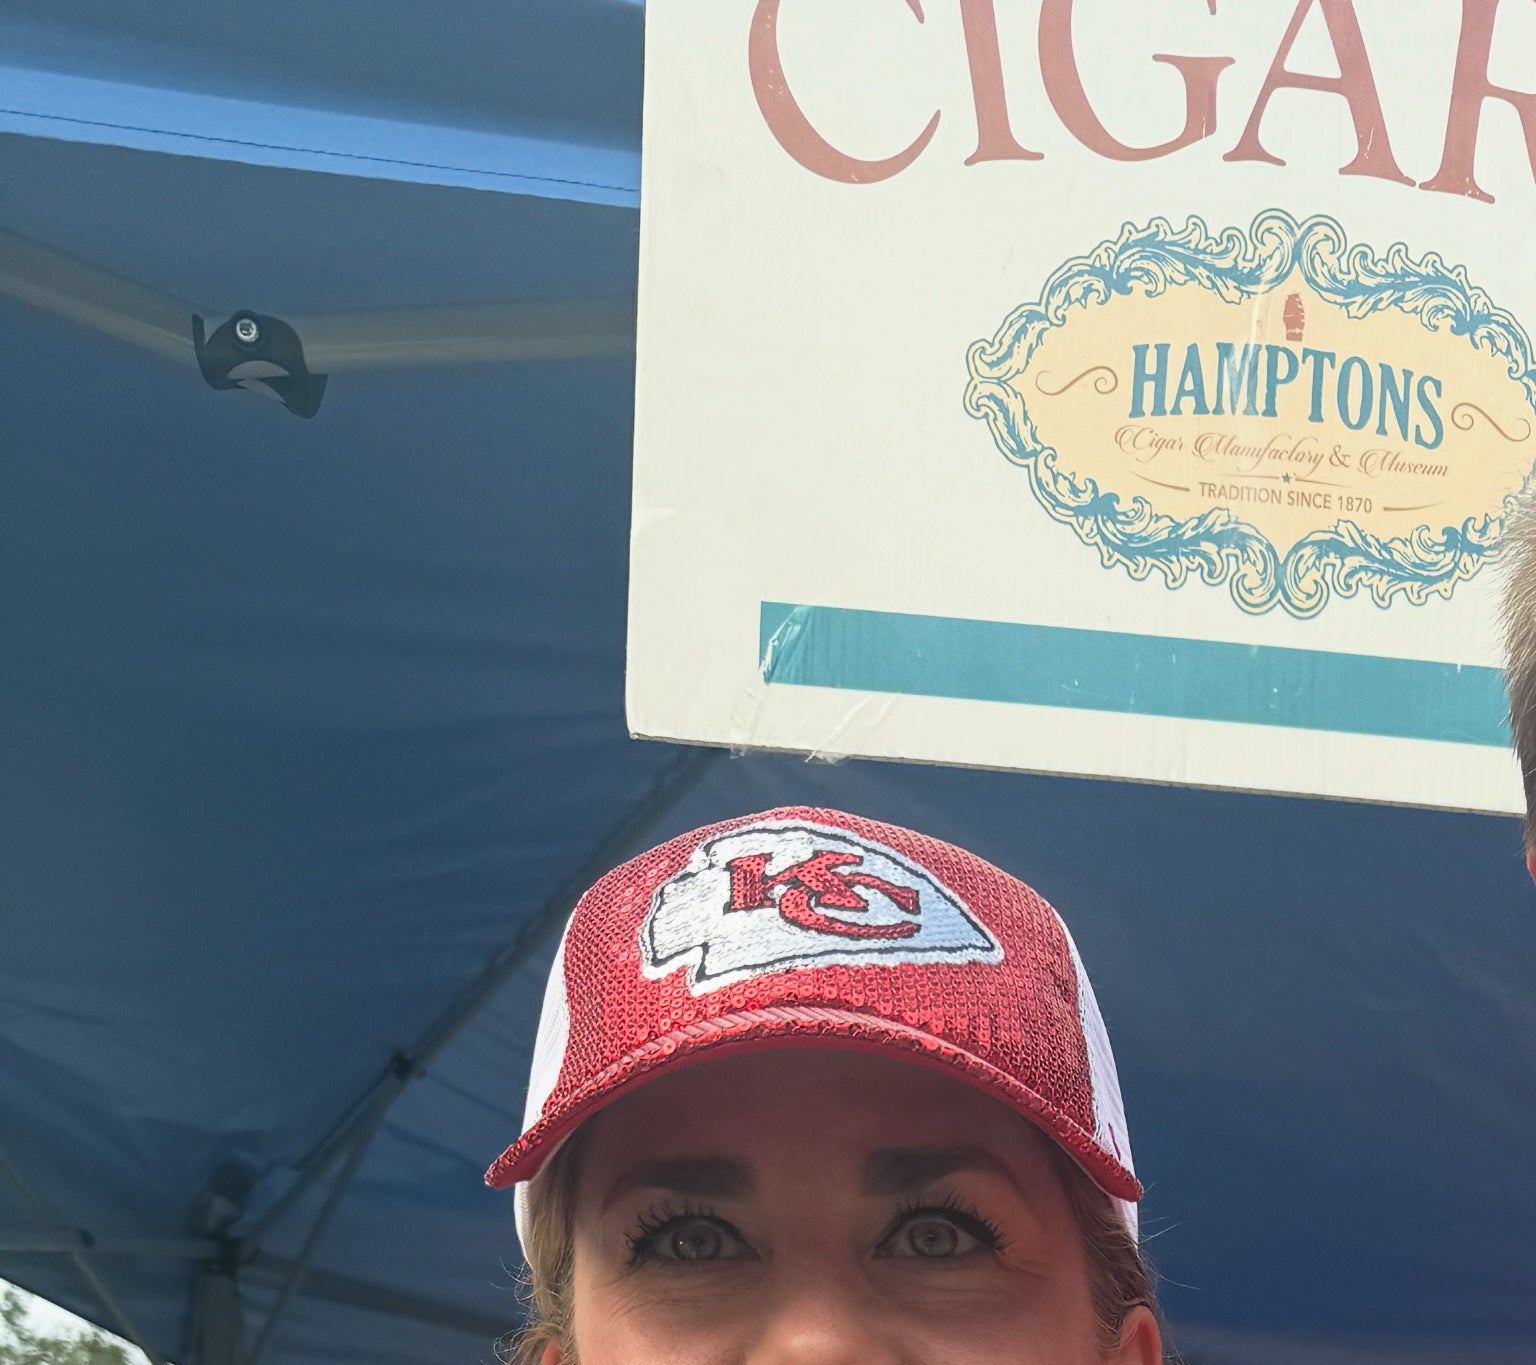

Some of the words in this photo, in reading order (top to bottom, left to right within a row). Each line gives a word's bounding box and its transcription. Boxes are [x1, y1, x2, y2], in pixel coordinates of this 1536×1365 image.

[1128, 341, 1445, 451] HAMPTONS
[1114, 424, 1184, 462] Cigar
[1192, 432, 1325, 476] Manufactory
[1328, 444, 1351, 468] &
[1357, 447, 1449, 477] Museum
[1198, 481, 1282, 505] TRADITION
[1286, 490, 1332, 510] SINCE
[1337, 495, 1373, 514] 1870
[724, 850, 921, 940] KC
